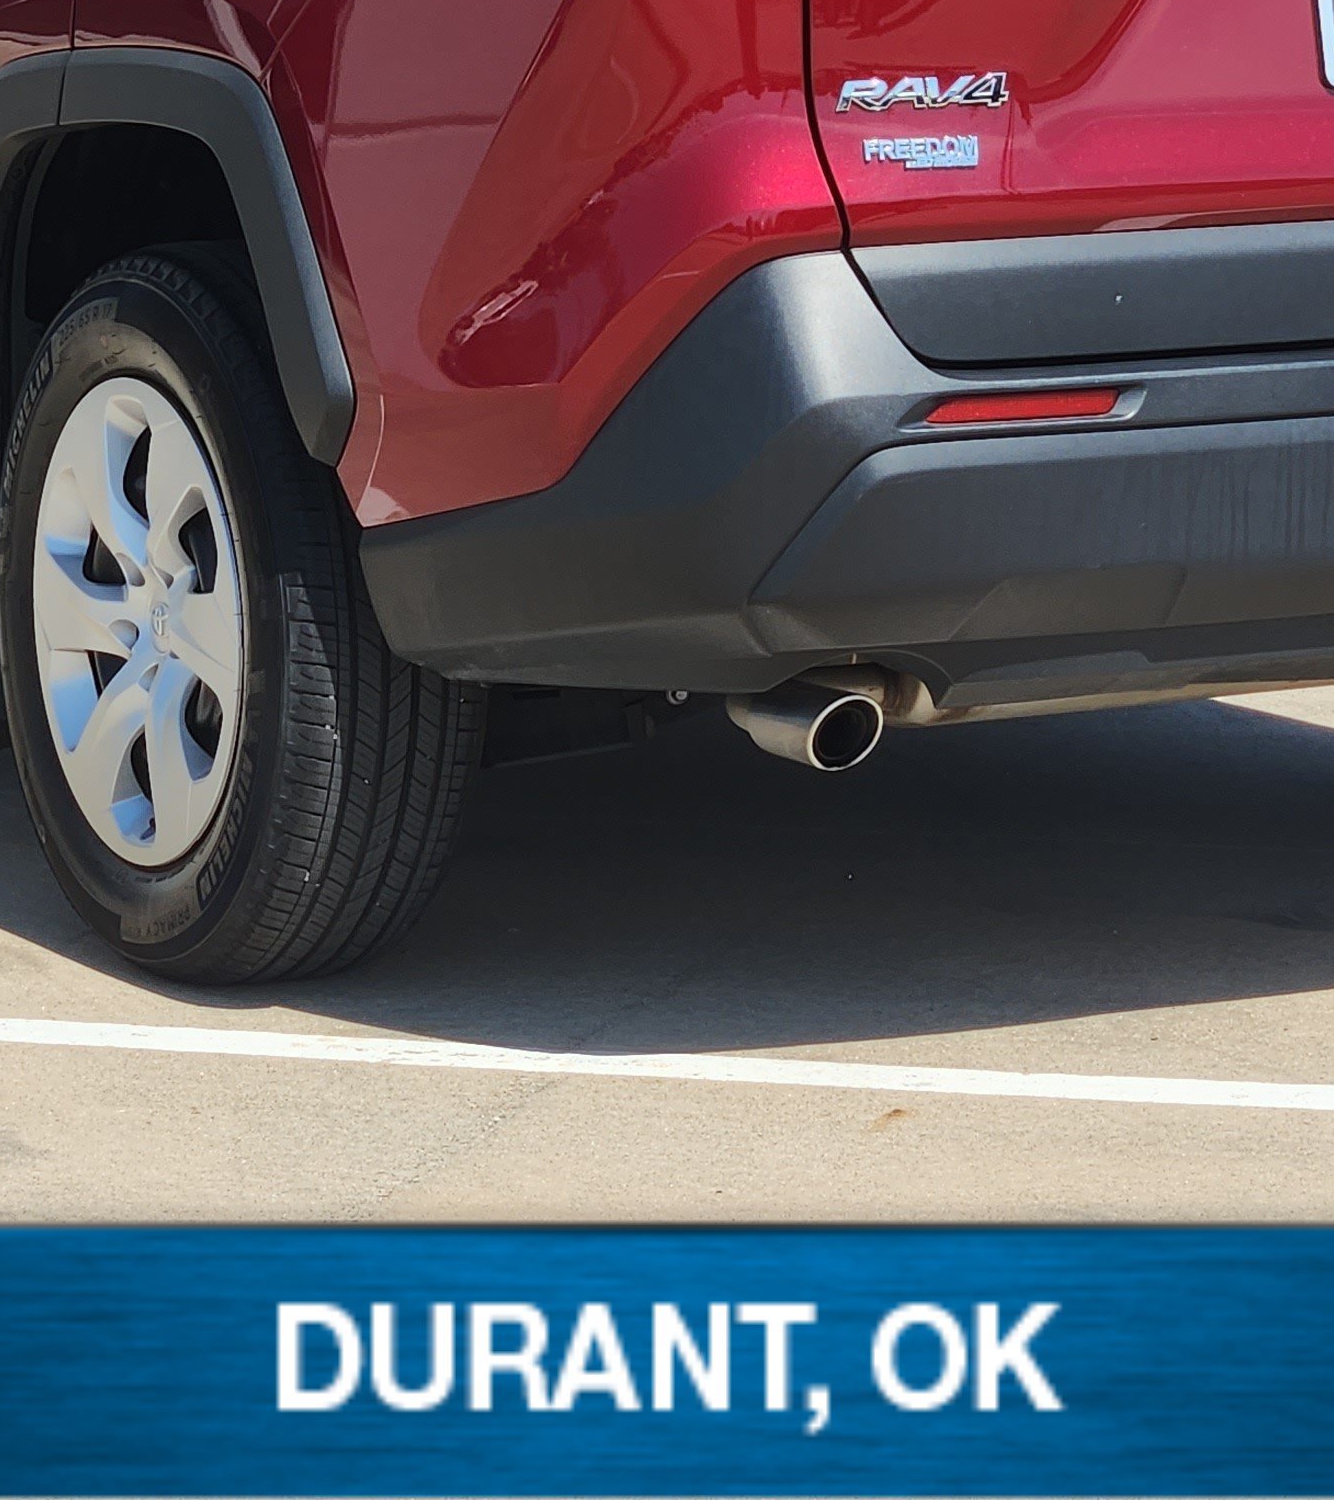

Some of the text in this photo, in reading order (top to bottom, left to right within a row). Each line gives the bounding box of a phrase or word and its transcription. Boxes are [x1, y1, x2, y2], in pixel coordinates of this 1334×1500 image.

[834, 71, 1009, 112] RAV4
[863, 135, 979, 162] FREEDOM
[2, 350, 51, 498] MICHELIN
[199, 750, 255, 902] MICHELIN
